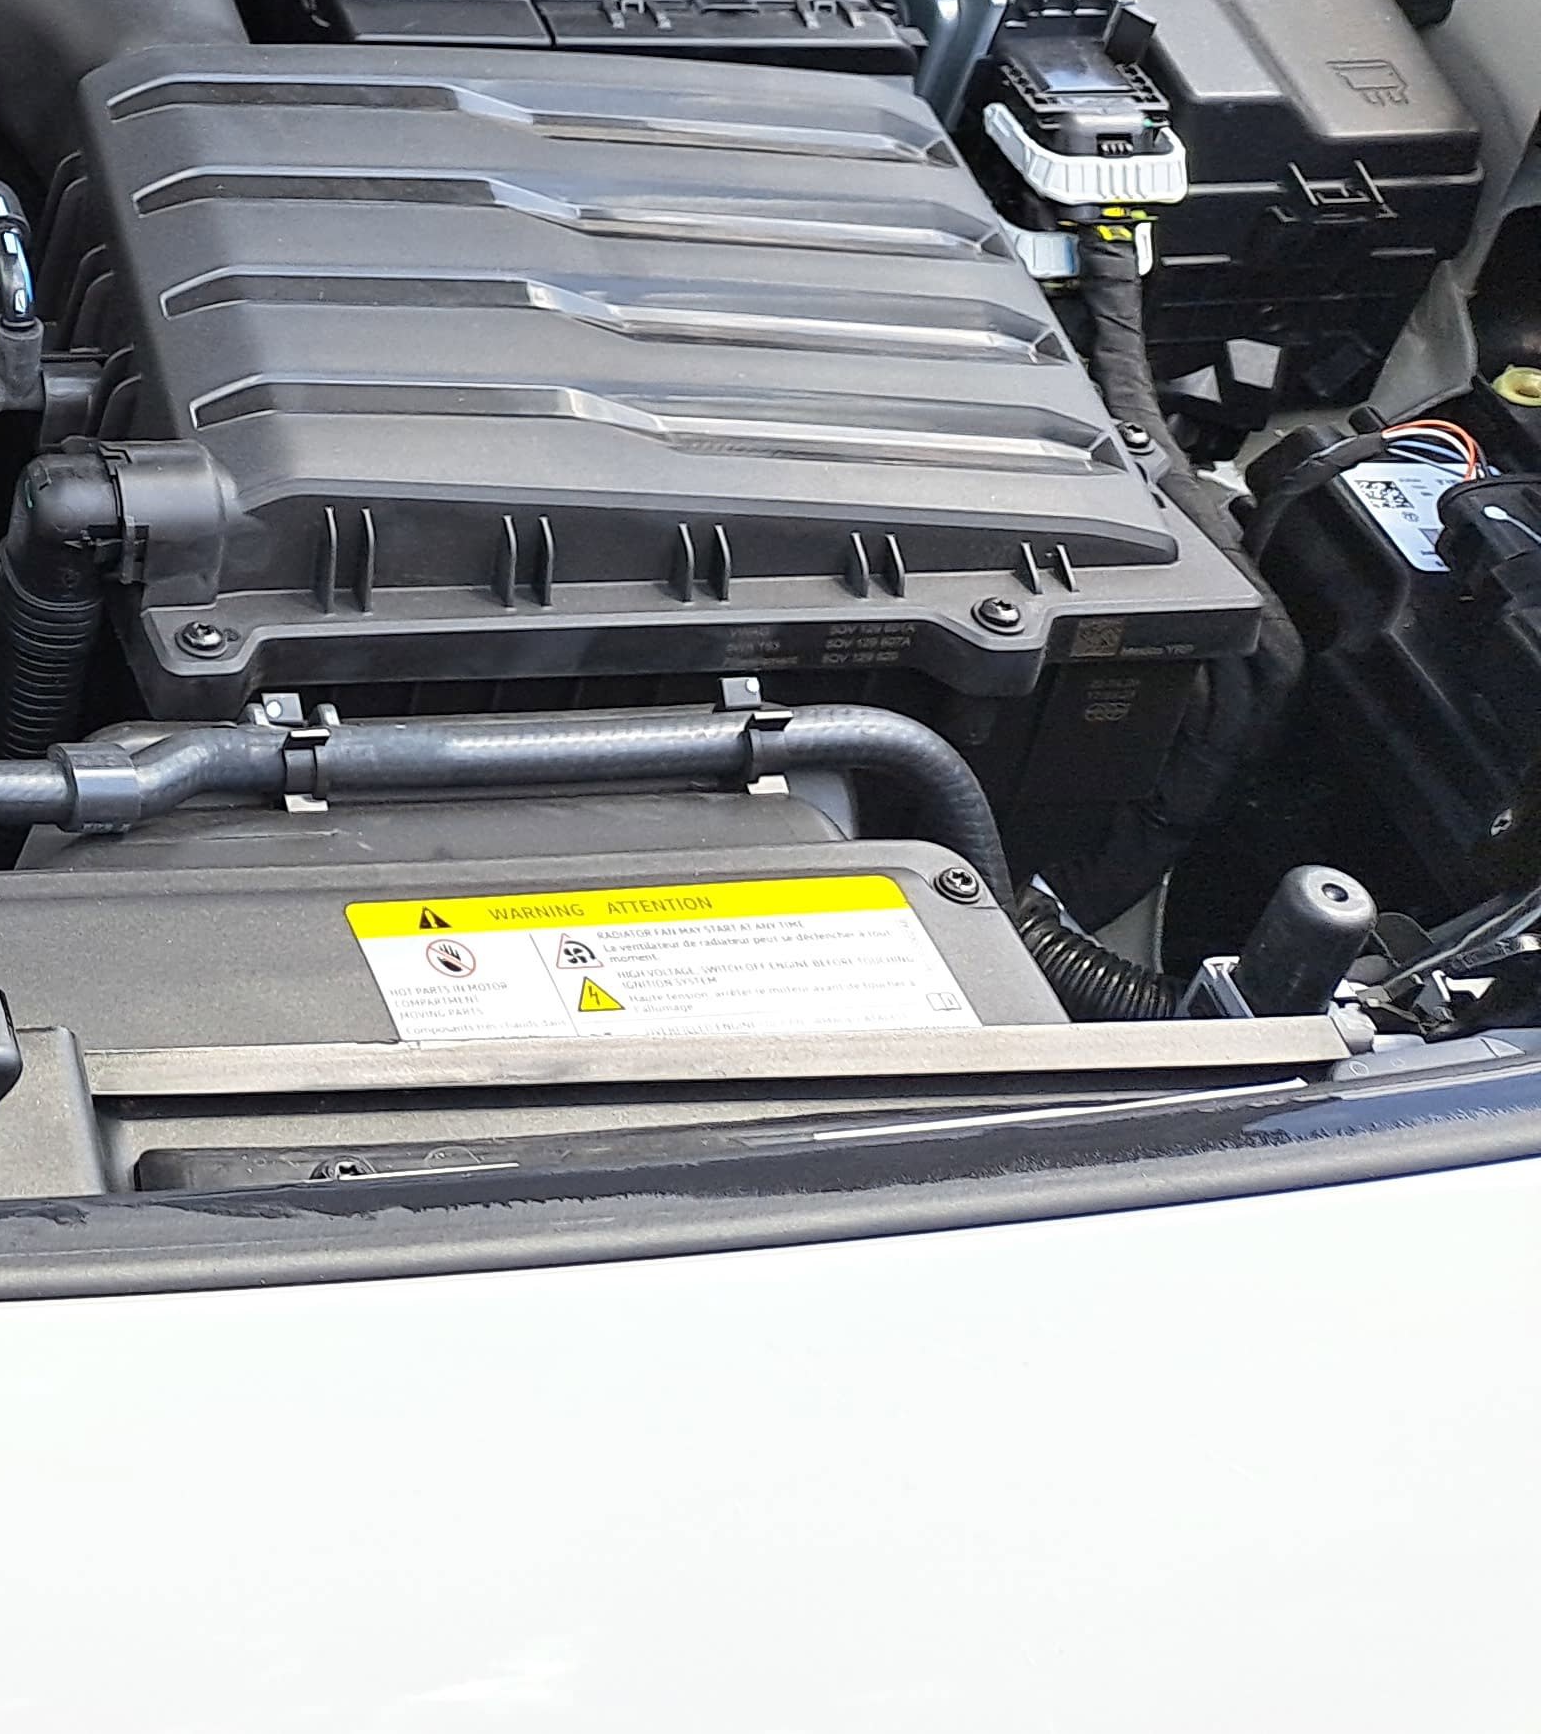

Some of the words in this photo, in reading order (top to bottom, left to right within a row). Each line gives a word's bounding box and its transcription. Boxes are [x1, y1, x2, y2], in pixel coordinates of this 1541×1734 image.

[488, 903, 585, 921] WARNING
[608, 897, 713, 915] ATTENTION
[597, 929, 652, 939] RADIATOR
[654, 927, 677, 936] FAN
[678, 926, 701, 935] MAY
[703, 924, 737, 934] START
[739, 923, 753, 931] AT
[755, 922, 776, 930] ANY
[778, 920, 805, 929] TIME
[621, 942, 680, 953] ventilateur
[683, 940, 697, 948] de
[699, 936, 750, 947] radiateur
[754, 933, 778, 944] peut
[617, 969, 645, 979] HIGH
[768, 961, 809, 971] ENGINE
[812, 958, 853, 968] BEFORE
[390, 986, 412, 997] HOT
[416, 984, 450, 995] PARTS
[466, 981, 508, 992] MOTOR
[622, 980, 673, 990] IGNITION
[675, 977, 718, 986] SYSTEM
[395, 995, 479, 1008] COMPARTMENT
[400, 1009, 446, 1021] MOVING
[449, 1007, 485, 1018] PARTS
